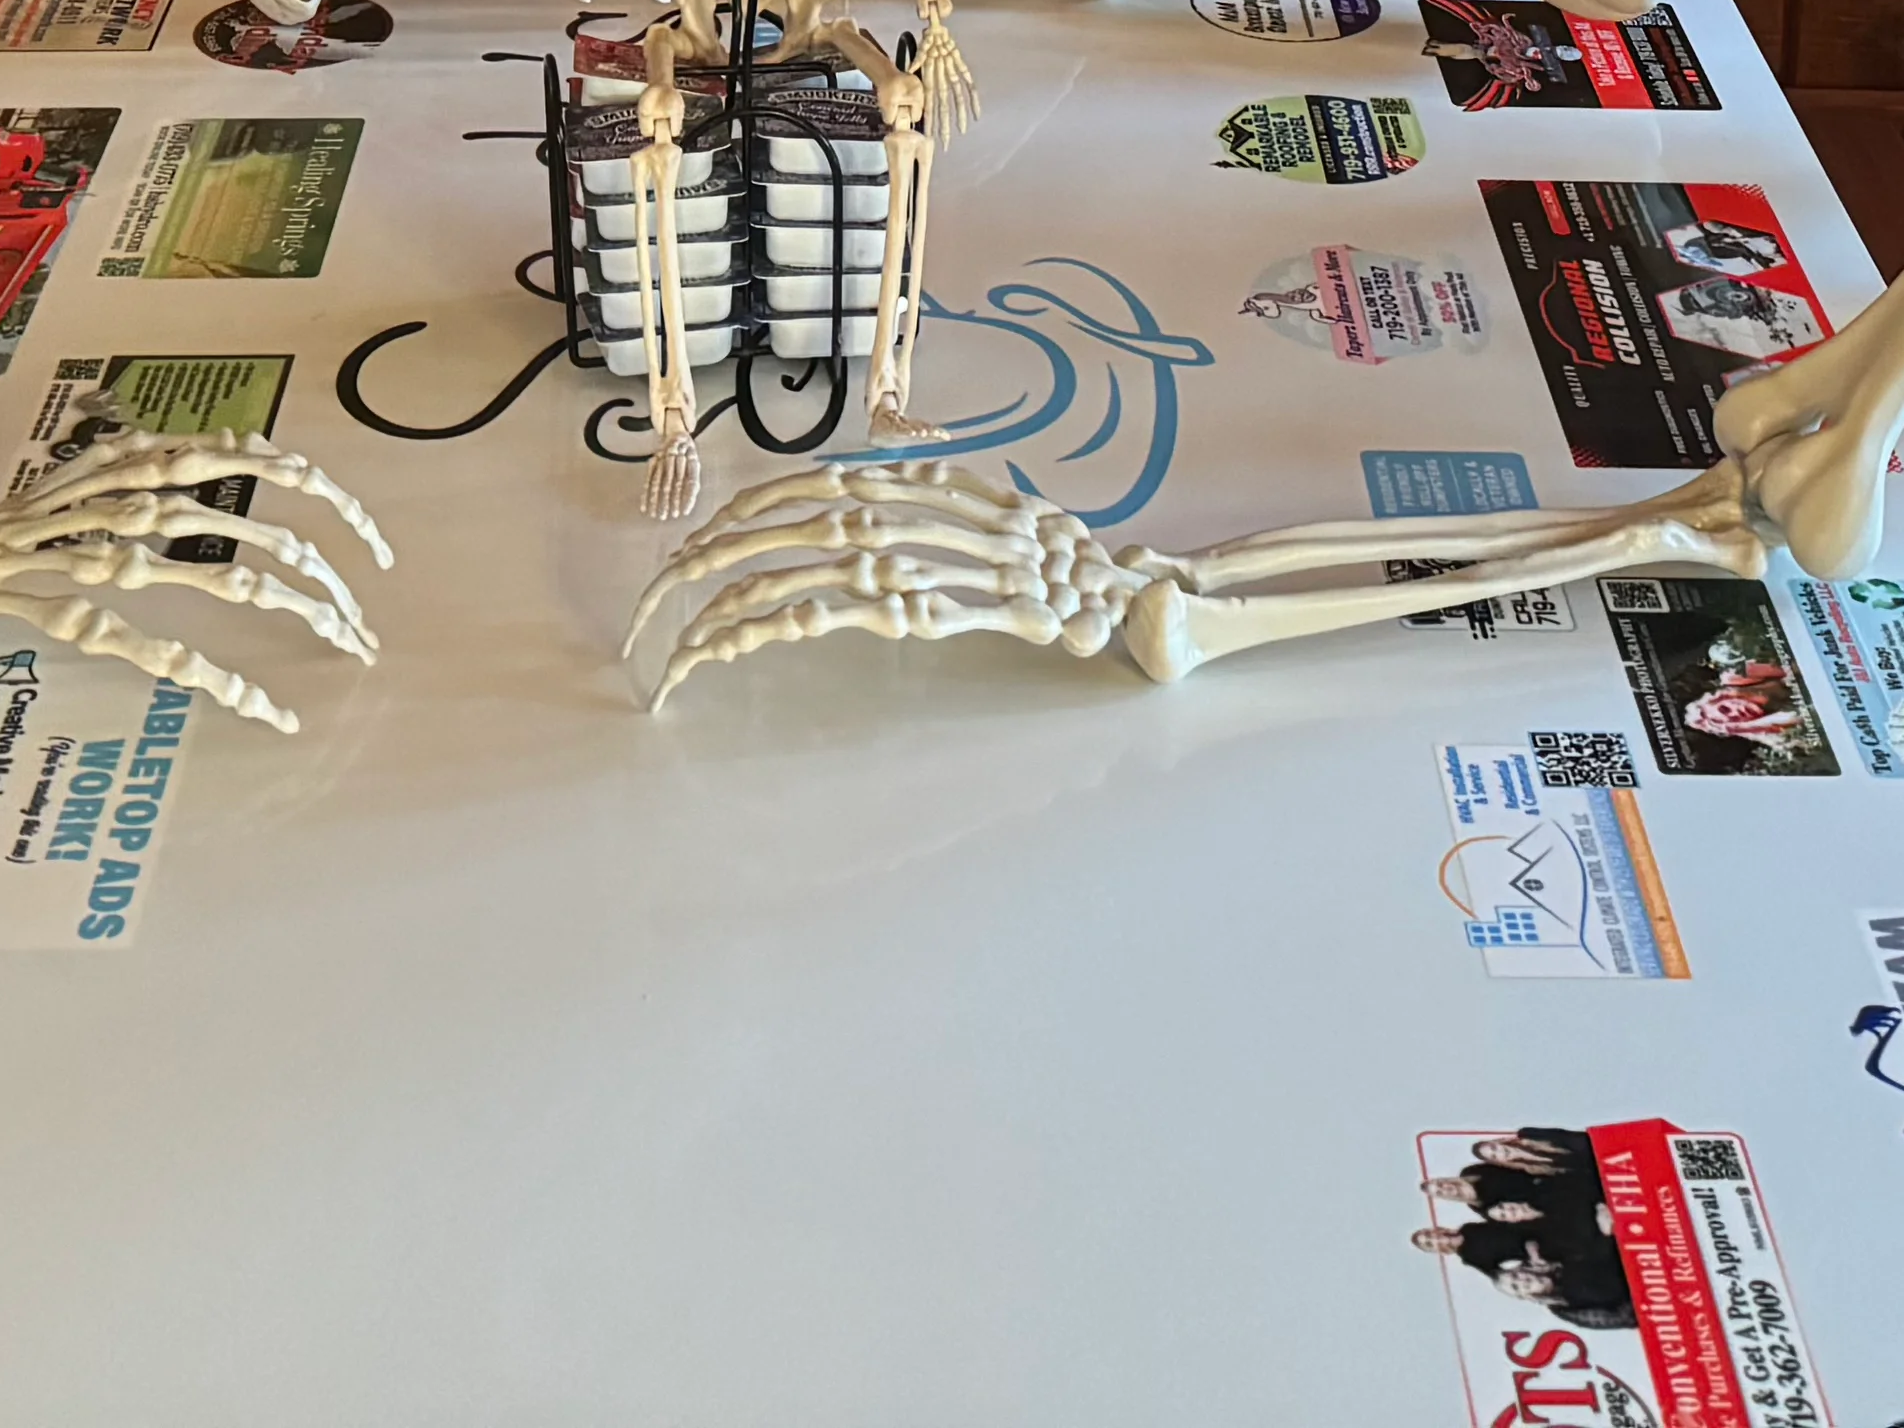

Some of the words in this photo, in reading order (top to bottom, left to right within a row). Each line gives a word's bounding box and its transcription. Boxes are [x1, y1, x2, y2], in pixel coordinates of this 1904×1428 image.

[1250, 104, 1280, 172] REMARKABLE
[1272, 121, 1297, 167] ROOFING
[1289, 114, 1314, 162] REMODEL
[1327, 99, 1364, 179] 719-931-4600
[289, 138, 343, 194] Healing
[271, 196, 324, 255] Springs
[1512, 221, 1537, 269] PRECISION
[1333, 283, 1354, 324] Haircuts
[1359, 276, 1374, 295] TEXT
[1408, 285, 1428, 326] Appointment
[1625, 281, 1651, 323] COLLISION
[1369, 308, 1383, 328] CALL
[1559, 260, 1613, 361] REGIONAL
[1583, 259, 1640, 364] COLLISION
[1562, 364, 1589, 407] QUALITY
[1798, 582, 1827, 625] Vehicles
[1618, 618, 1654, 693] PHOTOGRAPHY
[1815, 629, 1842, 658] Junk
[1832, 660, 1852, 682] For
[1884, 672, 1903, 690] We
[1837, 685, 1865, 711] Paid
[1644, 694, 1680, 767] SILVERNEKKO
[1852, 714, 1879, 746] Cash
[1445, 745, 1467, 795] Installation
[1467, 763, 1485, 794] Service
[1509, 753, 1536, 806] Commercial
[1871, 748, 1892, 773] Top
[46, 739, 124, 860] WORK!
[1493, 759, 1519, 809] Residential
[1454, 798, 1473, 823] HVAC
[1576, 828, 1598, 856] SYSTEMS
[1586, 860, 1609, 891] CONTROL
[78, 858, 139, 939] ADS
[1606, 928, 1633, 973] INTEGRATED
[1604, 1151, 1646, 1212] FHA
[1658, 1186, 1696, 1281] Refinances
[1692, 1187, 1751, 1319] Pre-Approval!
[1679, 1290, 1703, 1306] &
[1733, 1325, 1759, 1341] A
[1694, 1312, 1731, 1407] Purchases
[1741, 1346, 1769, 1382] Get
[1751, 1389, 1778, 1407] &
